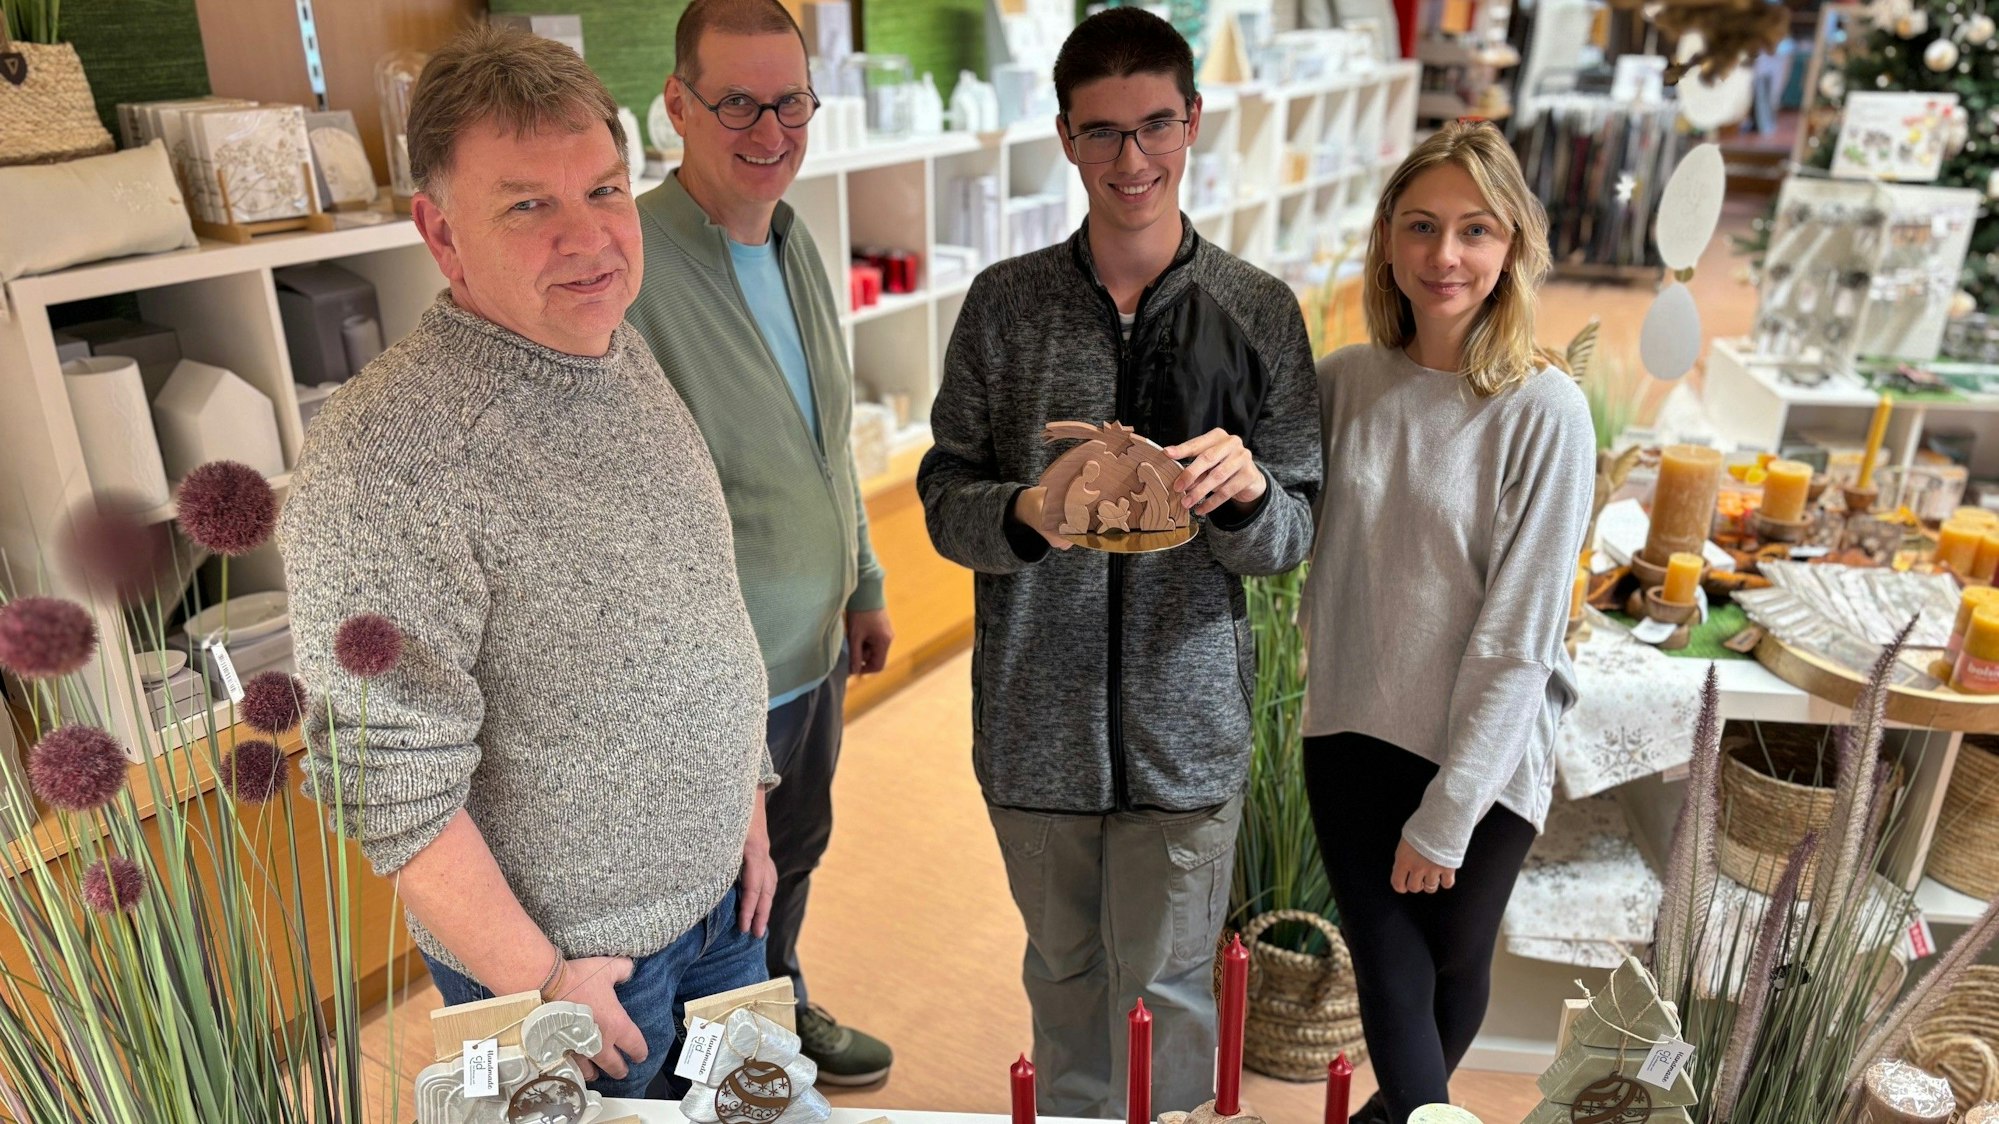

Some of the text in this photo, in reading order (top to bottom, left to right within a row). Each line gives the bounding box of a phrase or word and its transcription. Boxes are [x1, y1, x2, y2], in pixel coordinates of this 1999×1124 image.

[694, 1036, 706, 1053] cjd
[472, 1055, 486, 1070] cjd
[1659, 1050, 1672, 1065] cjd
